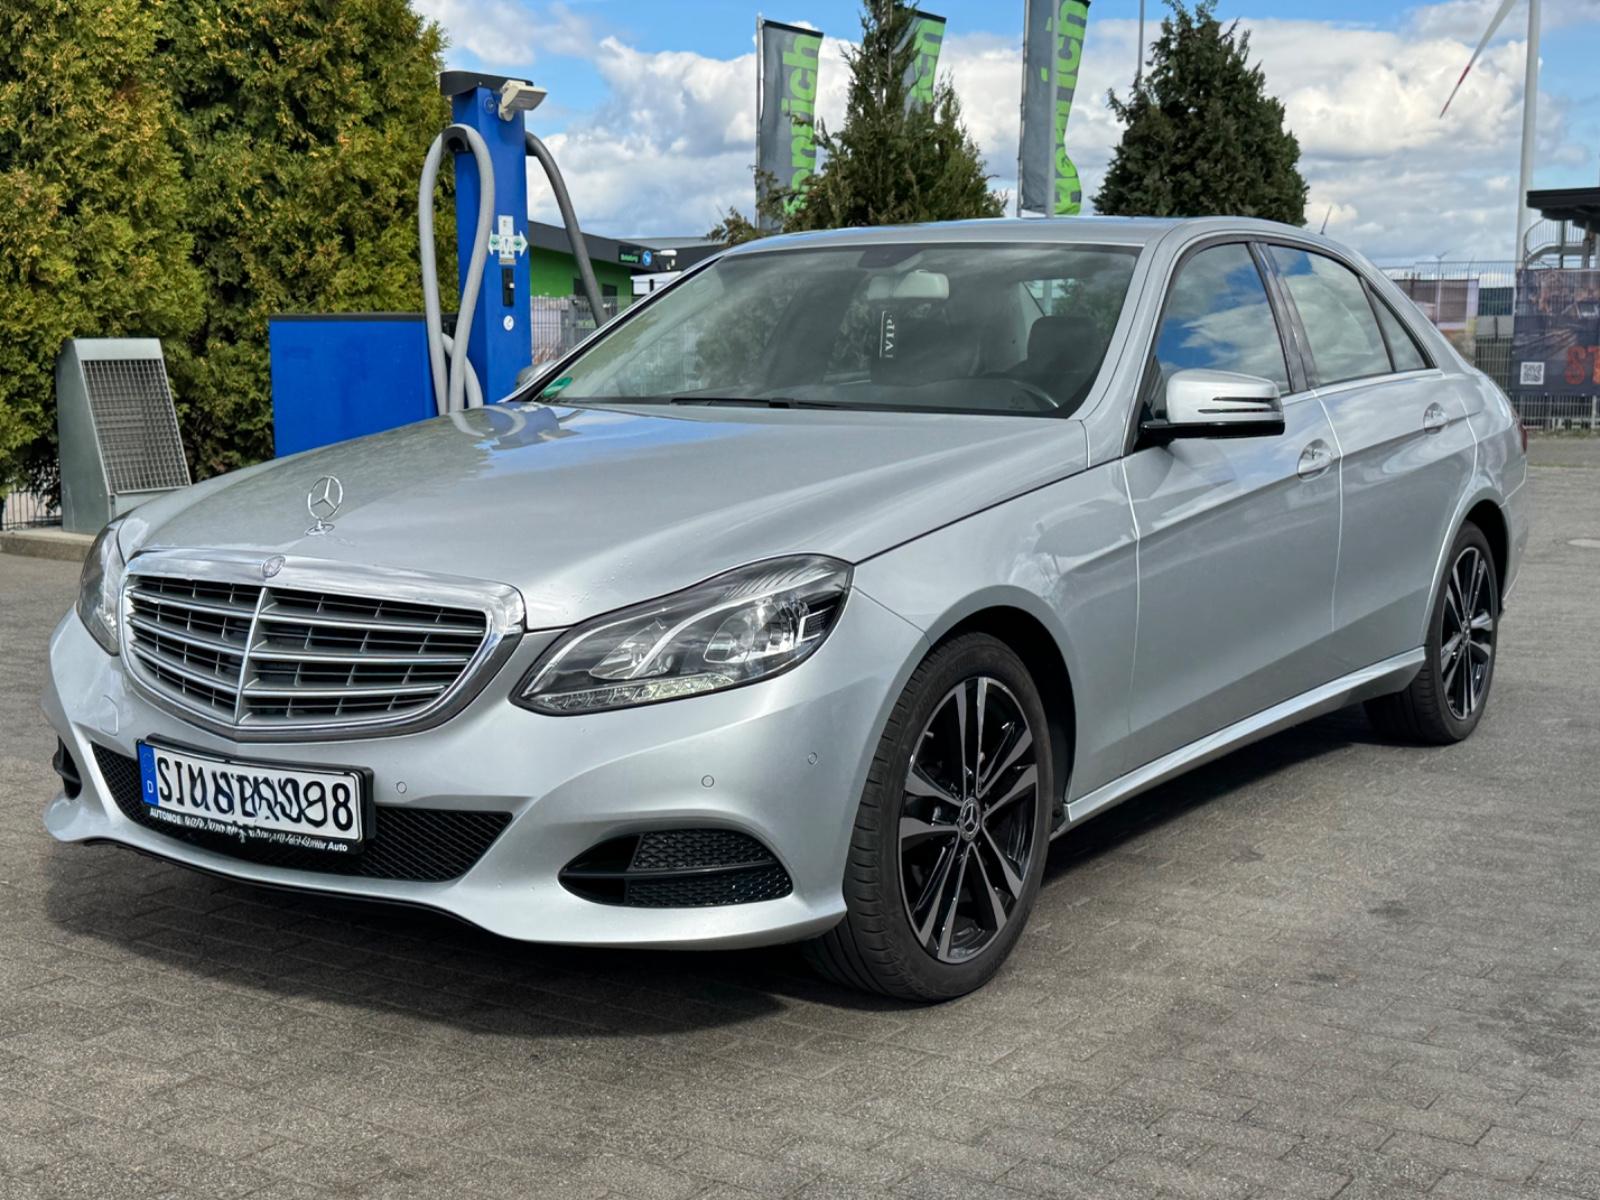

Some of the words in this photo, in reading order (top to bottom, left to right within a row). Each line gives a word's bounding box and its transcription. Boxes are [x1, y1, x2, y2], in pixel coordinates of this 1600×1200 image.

[884, 318, 896, 352] VIP
[147, 780, 154, 793] D
[327, 841, 348, 852] Auto
